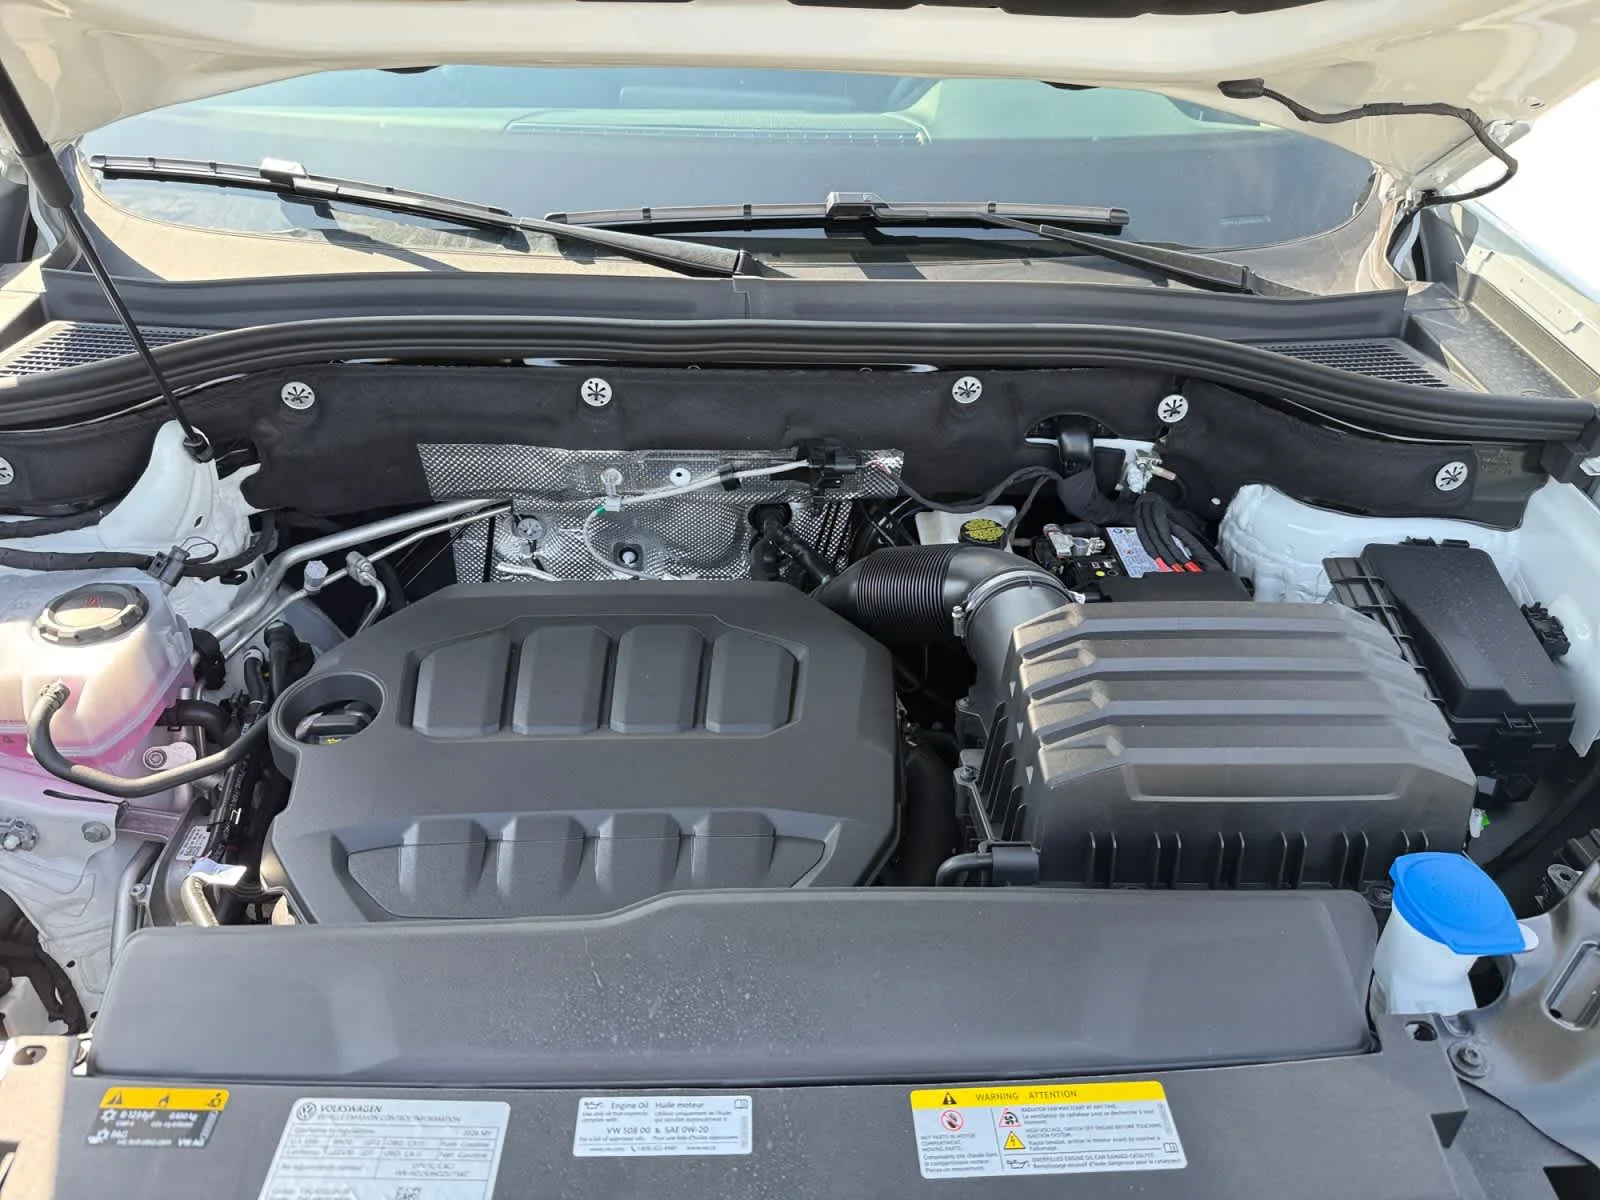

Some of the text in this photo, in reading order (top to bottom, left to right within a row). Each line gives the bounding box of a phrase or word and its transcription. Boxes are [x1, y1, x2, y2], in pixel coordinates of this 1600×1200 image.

[975, 1089, 1077, 1101] WARNING ATTENTION
[320, 1104, 382, 1112] VOLKSWAGEN
[610, 1102, 636, 1110] Engine
[655, 1101, 675, 1109] Huile
